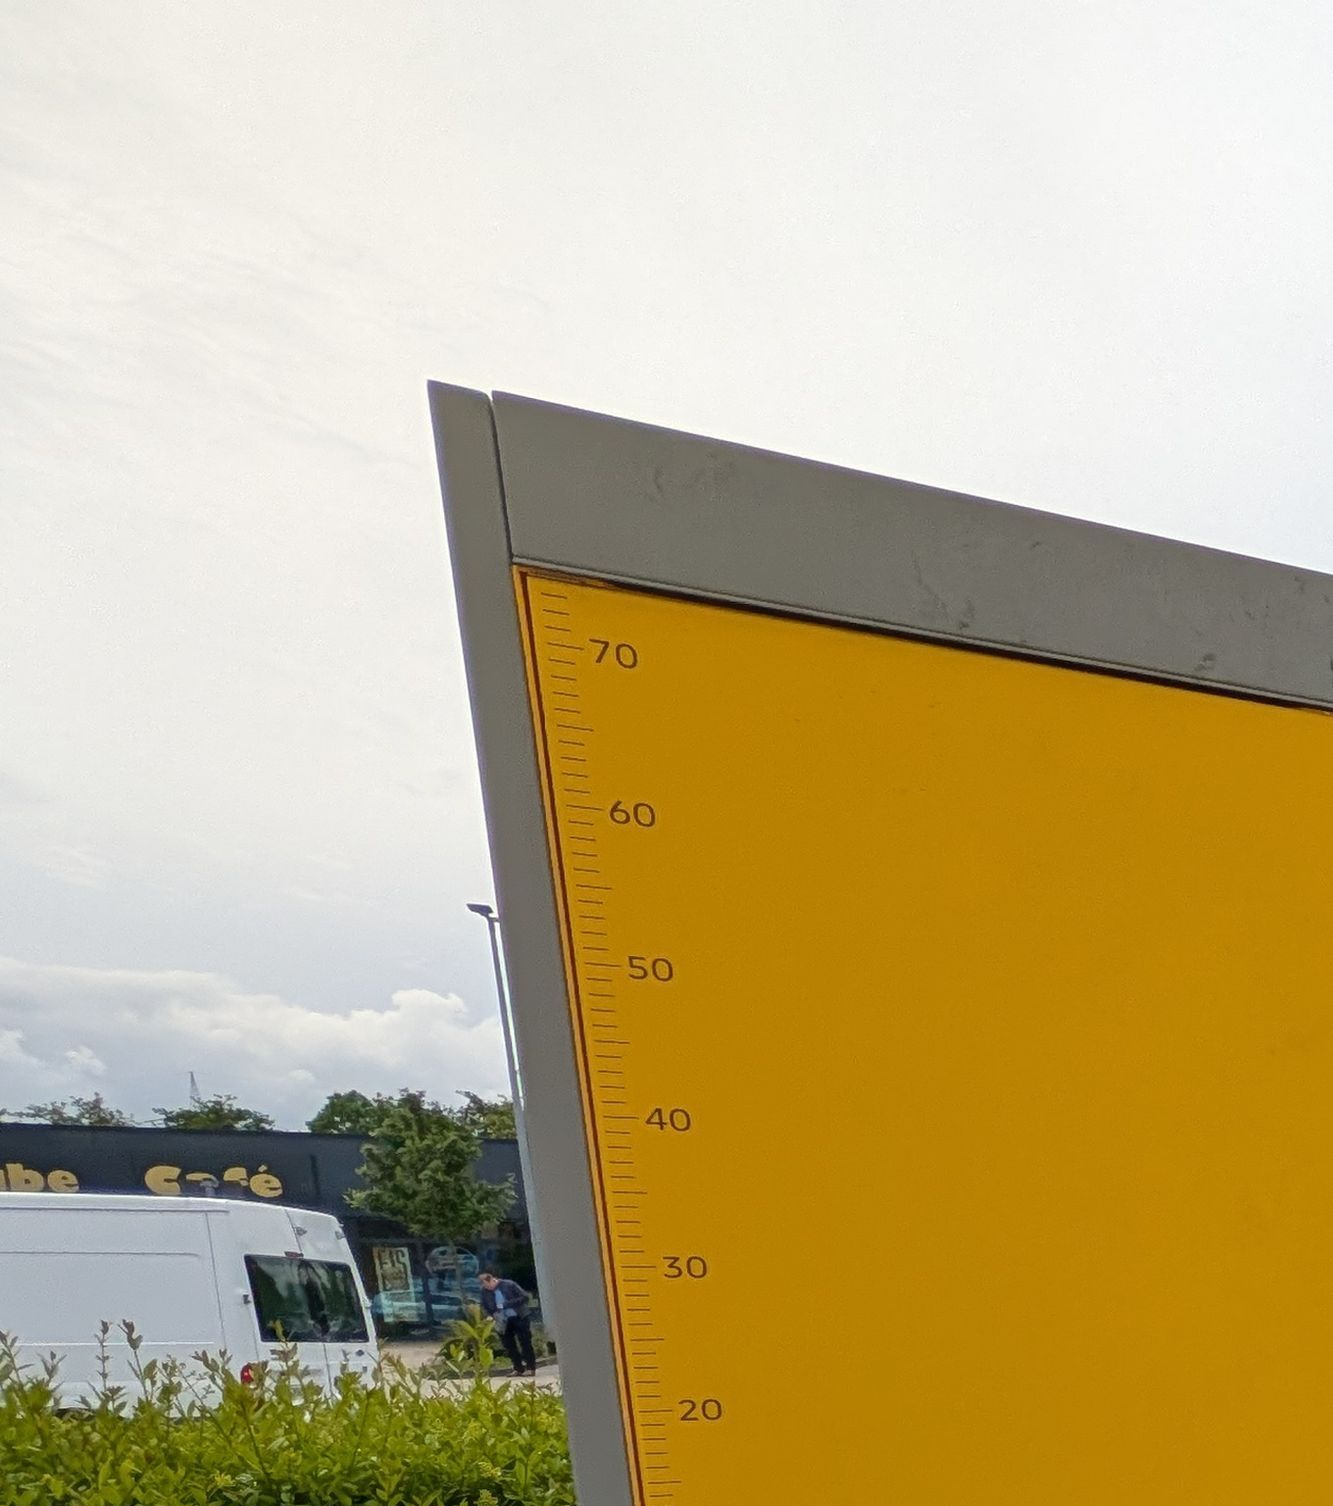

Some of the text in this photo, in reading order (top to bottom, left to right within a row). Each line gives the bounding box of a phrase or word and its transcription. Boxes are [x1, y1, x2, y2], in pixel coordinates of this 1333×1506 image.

[588, 638, 638, 669] 70
[609, 800, 656, 827] 60
[627, 955, 673, 982] 50
[645, 1107, 691, 1132] 40
[0, 1163, 79, 1193] be
[662, 1256, 707, 1279] 30
[678, 1398, 722, 1421] 20
